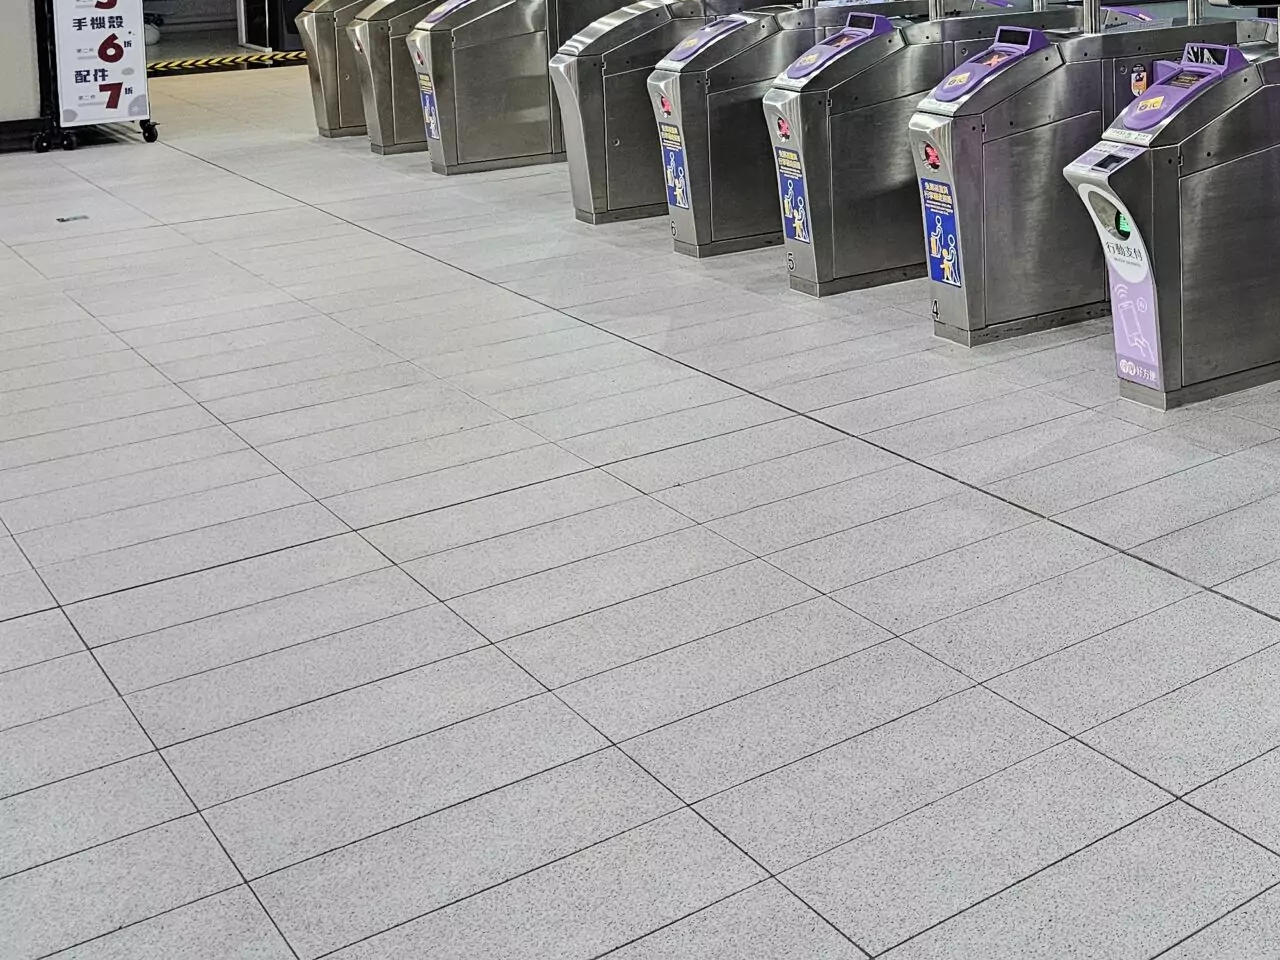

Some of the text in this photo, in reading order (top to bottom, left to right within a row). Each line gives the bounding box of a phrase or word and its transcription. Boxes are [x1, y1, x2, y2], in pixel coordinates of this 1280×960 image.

[72, 15, 124, 31] 手機殼
[74, 68, 109, 84] 配件
[670, 220, 677, 237] 6
[1106, 241, 1143, 261] 行動支付
[787, 252, 795, 271] 5
[931, 299, 940, 321] 4
